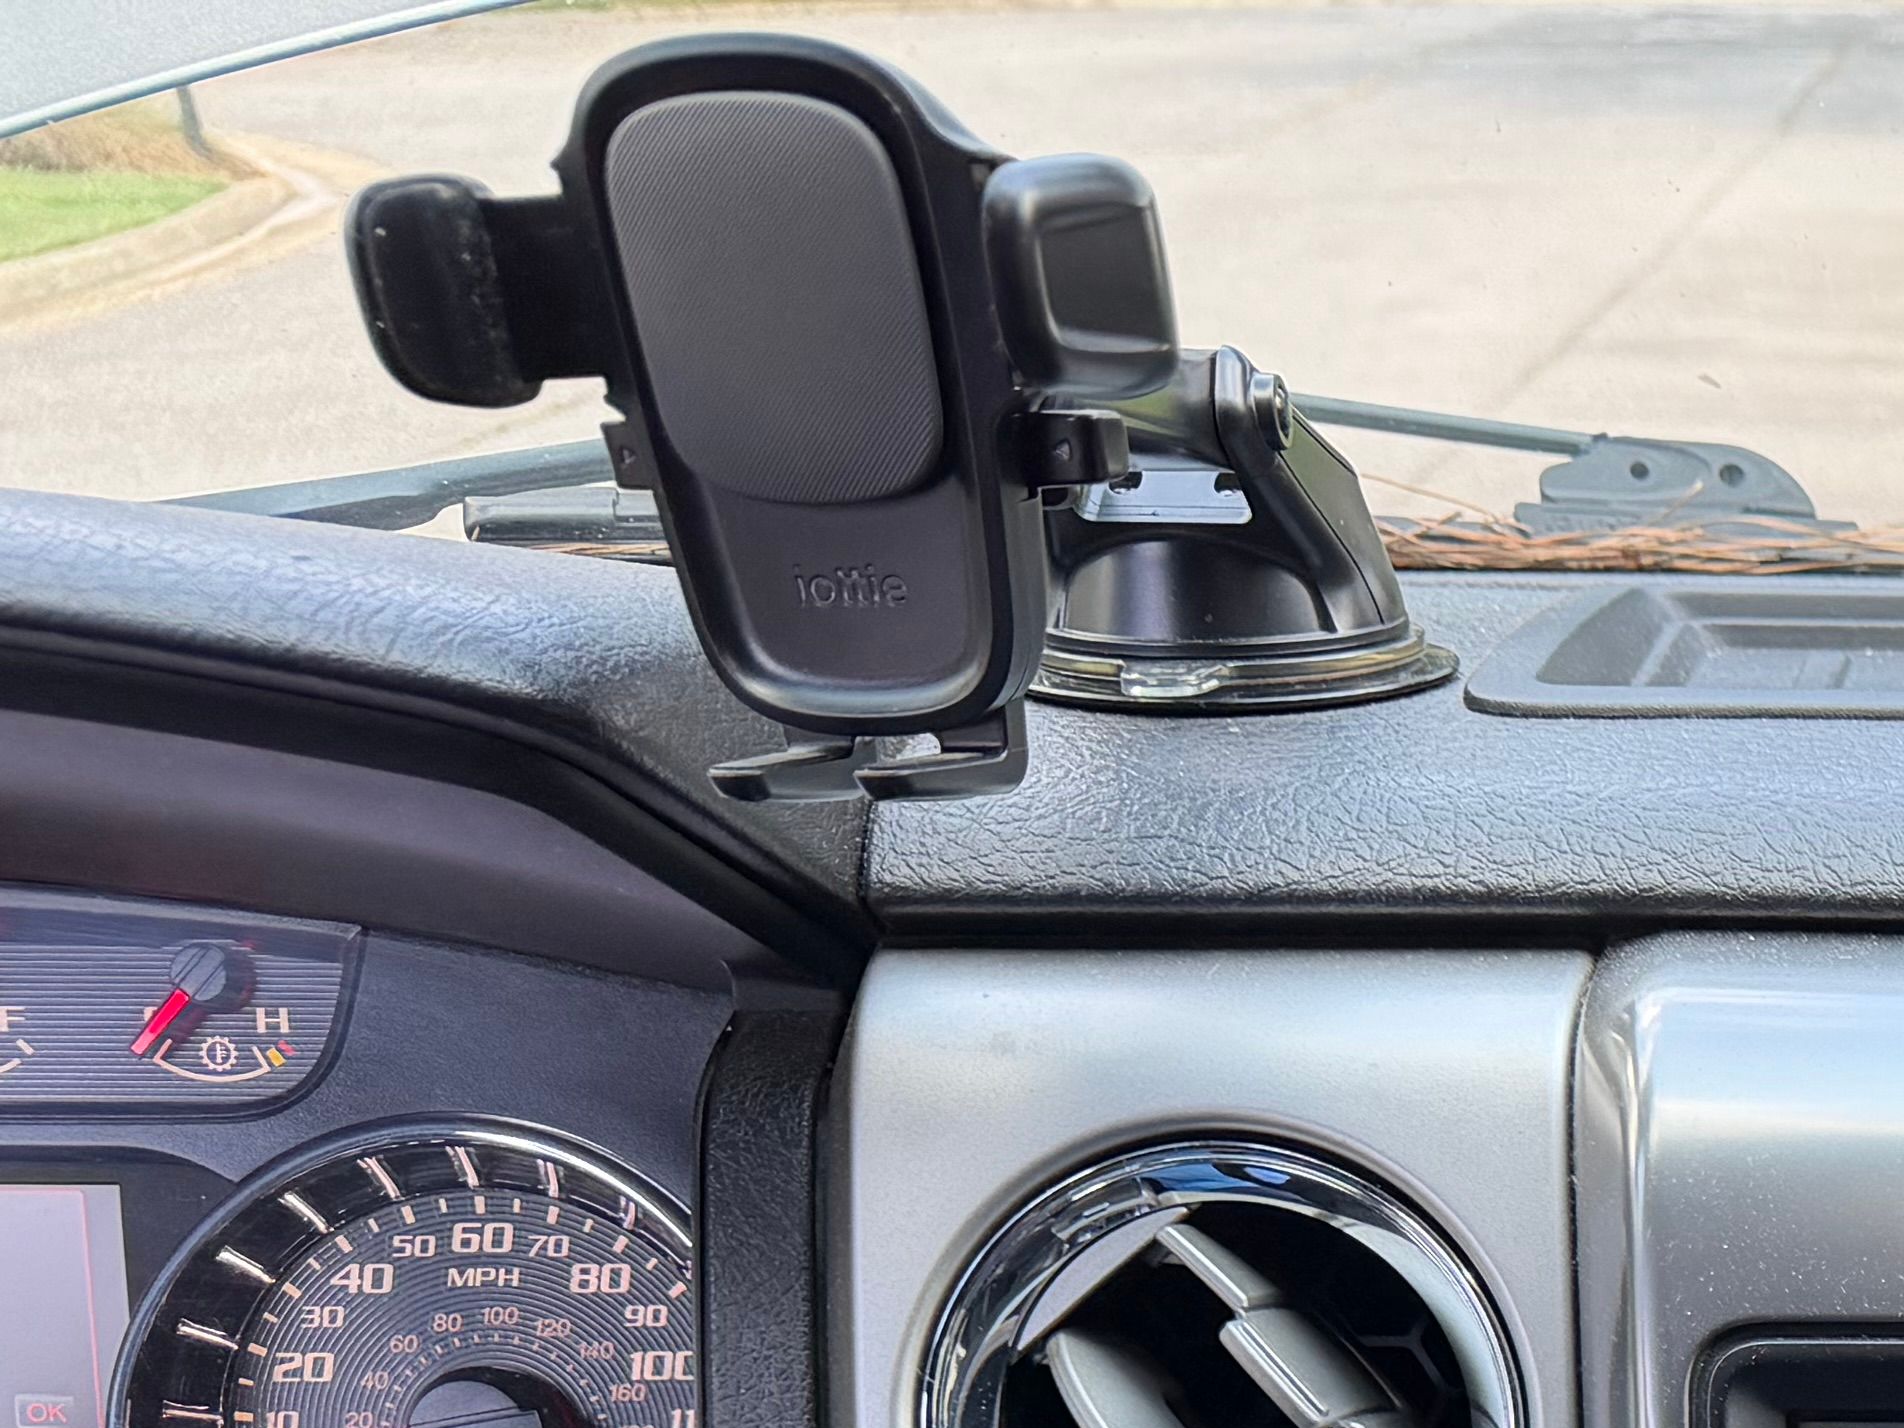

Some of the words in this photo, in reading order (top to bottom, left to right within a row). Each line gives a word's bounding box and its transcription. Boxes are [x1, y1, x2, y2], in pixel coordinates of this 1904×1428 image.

[255, 1007, 290, 1033] H
[391, 1233, 437, 1258] 50
[450, 1223, 514, 1254] 60
[528, 1234, 570, 1259] 70
[330, 1263, 394, 1294] 40
[447, 1267, 520, 1288] MPH
[569, 1263, 631, 1294] 80
[301, 1305, 345, 1328] 30
[433, 1313, 462, 1334] 80
[481, 1307, 520, 1326] 100
[624, 1305, 668, 1328] 90
[535, 1319, 571, 1338] 120
[390, 1334, 419, 1355] 60
[273, 1353, 334, 1382] 20
[360, 1371, 389, 1391] 40
[609, 1382, 647, 1402] 160
[26, 1402, 67, 1422] OK
